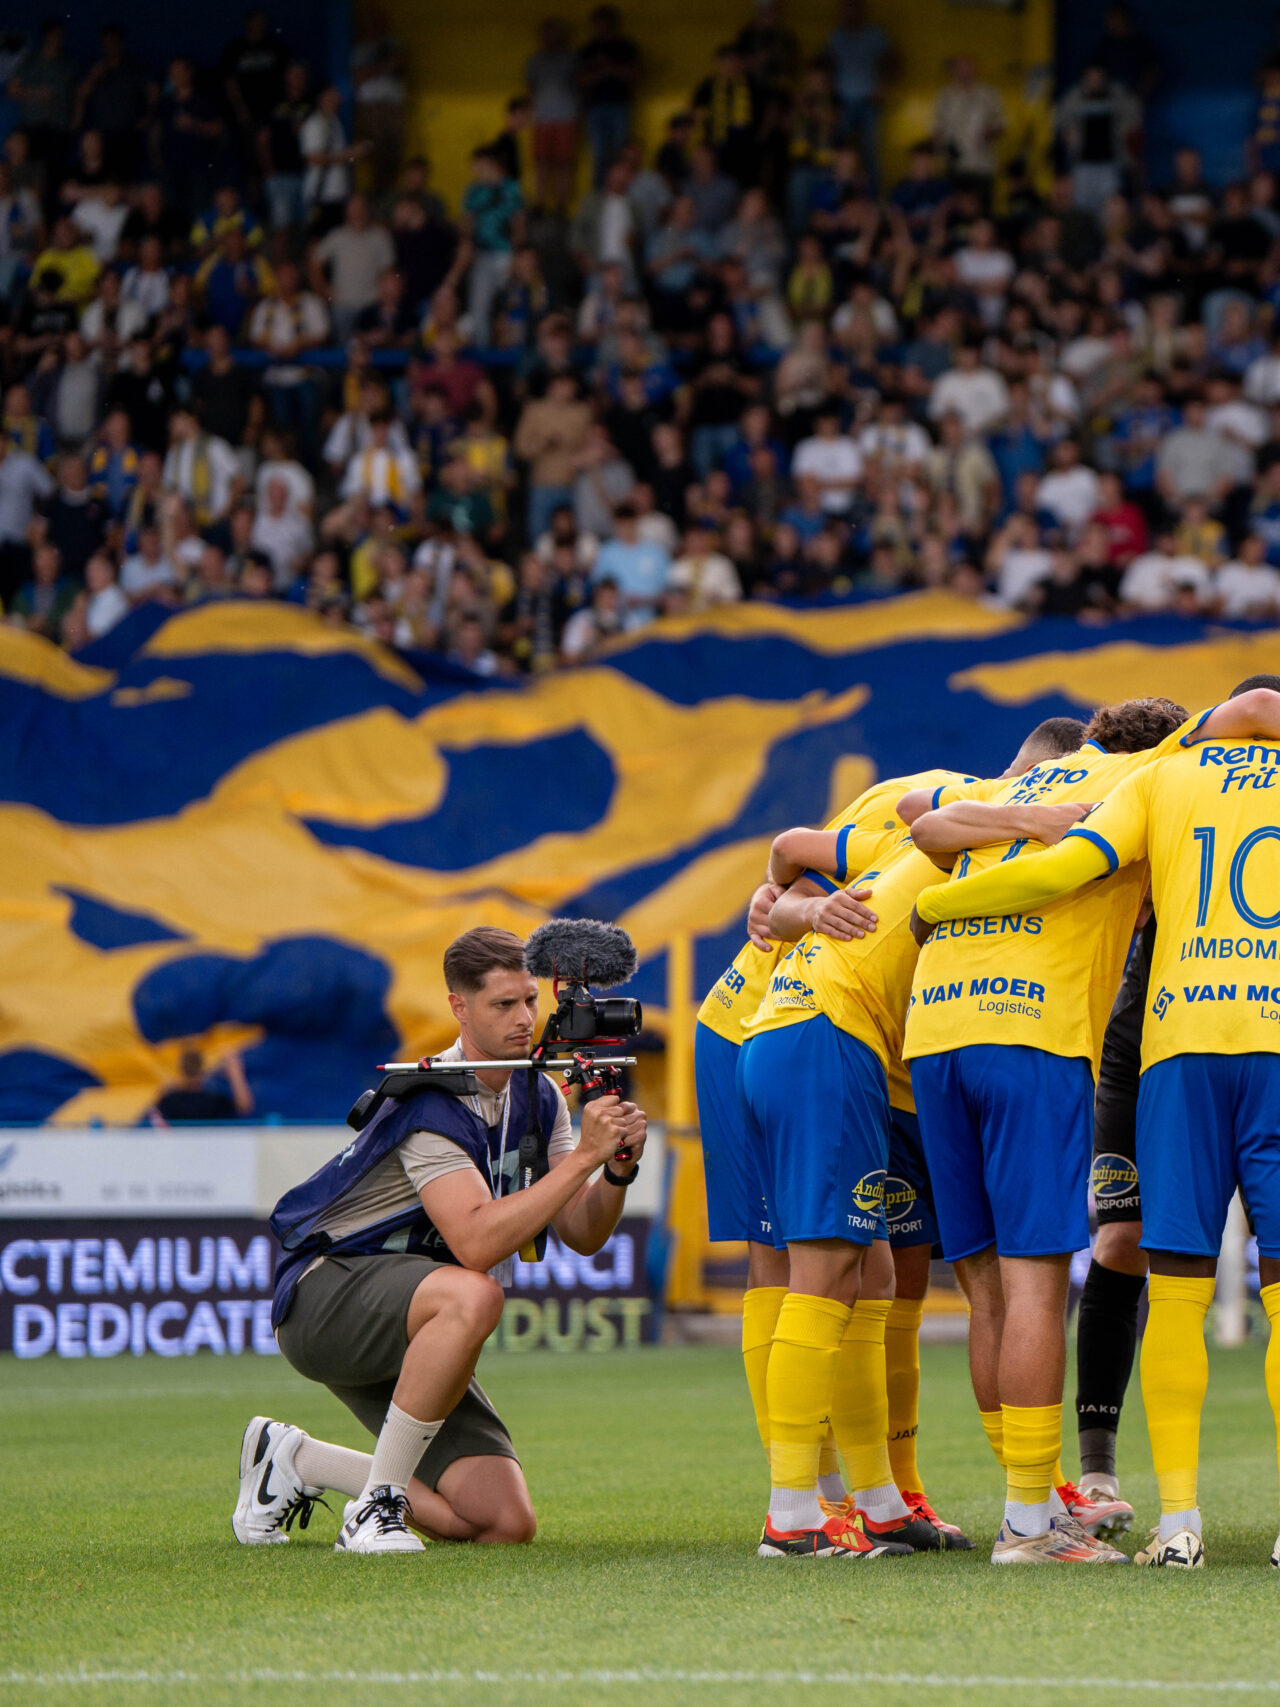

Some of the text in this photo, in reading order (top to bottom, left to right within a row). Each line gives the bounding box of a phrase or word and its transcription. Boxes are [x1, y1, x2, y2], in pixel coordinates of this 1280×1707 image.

[1220, 765, 1278, 793] Frit
[922, 976, 1046, 1006] VAN MOER
[1183, 984, 1237, 1003] VAN
[978, 999, 1041, 1020] Logistics
[0, 1235, 271, 1296] CTEMIUM
[1079, 1404, 1118, 1415] JAKO
